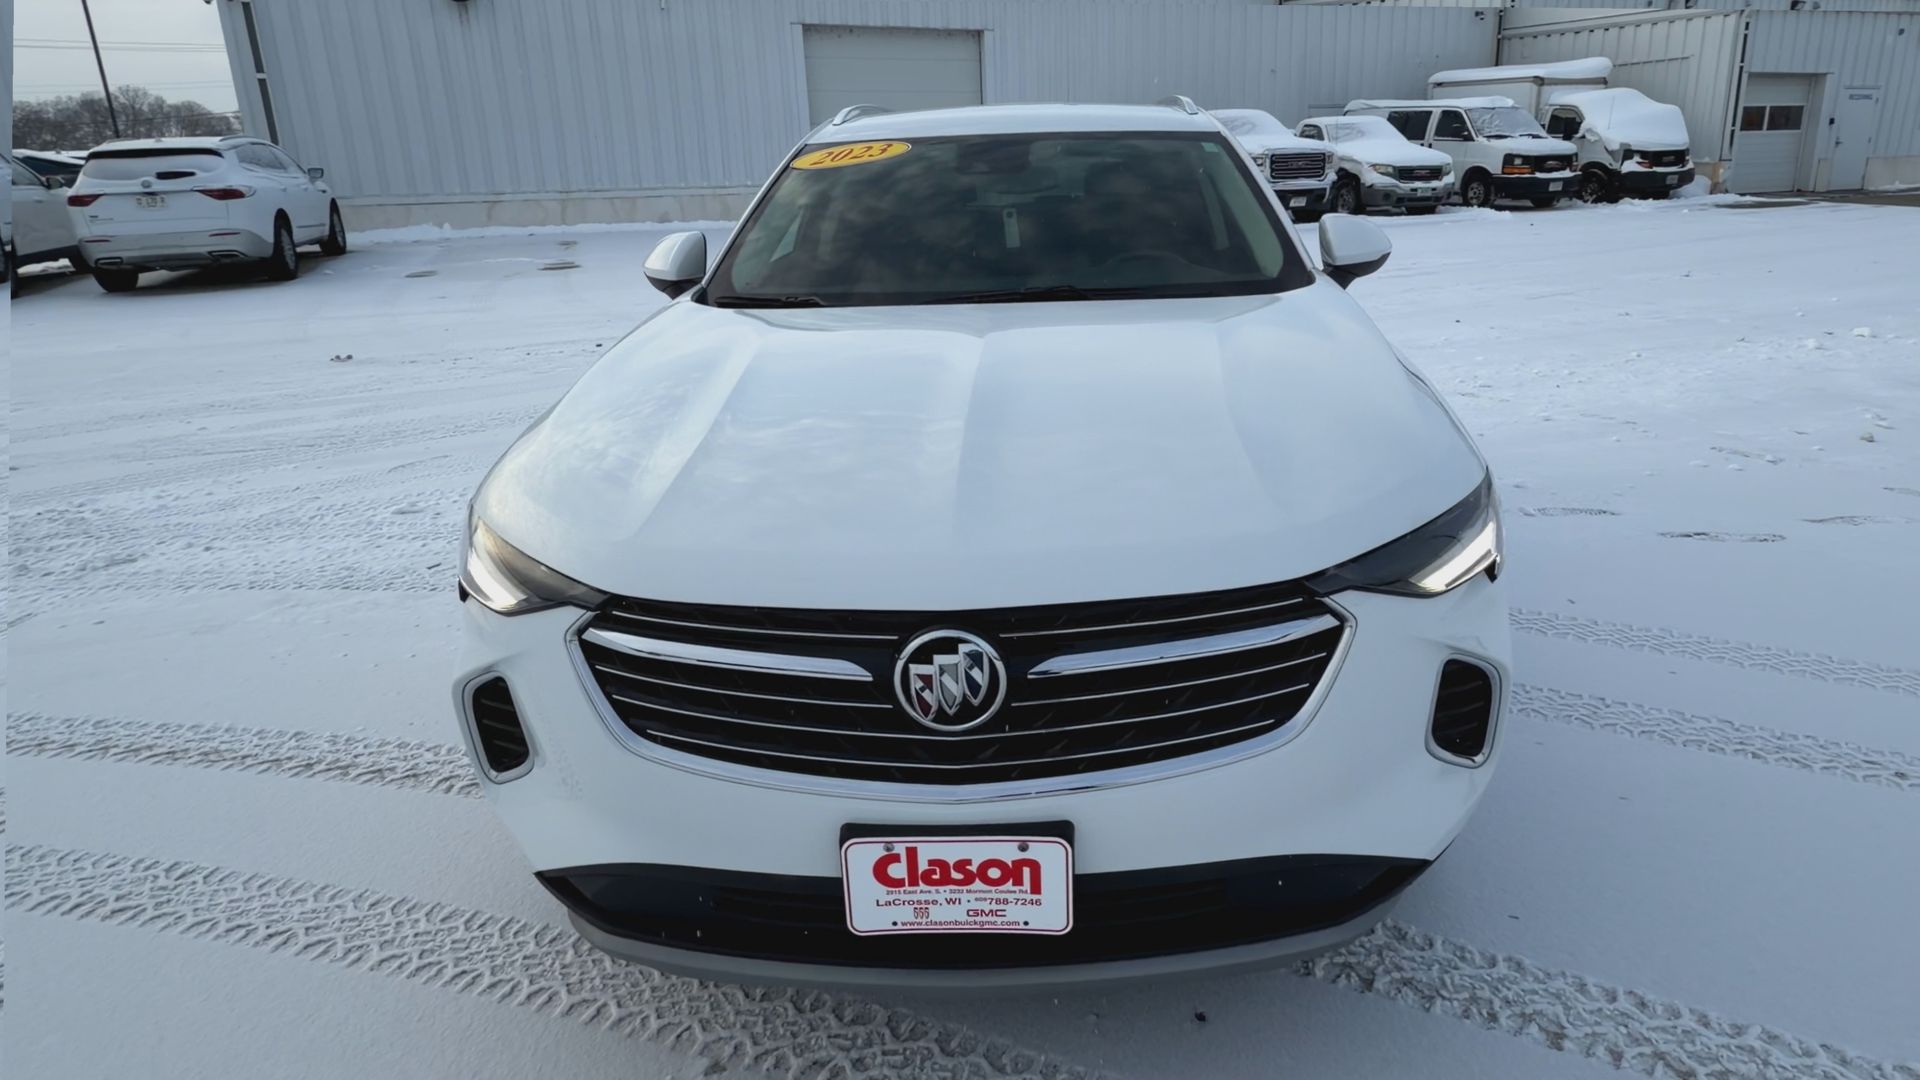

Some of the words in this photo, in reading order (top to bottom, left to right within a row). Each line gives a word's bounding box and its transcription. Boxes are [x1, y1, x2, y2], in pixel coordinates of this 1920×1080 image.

[809, 143, 894, 166] 2023
[872, 846, 1042, 895] Clason
[876, 898, 943, 907] LaCrosse,
[945, 897, 962, 905] WI
[966, 909, 1007, 917] GMC
[901, 919, 1021, 927] www.clasonbuickgmc.com
